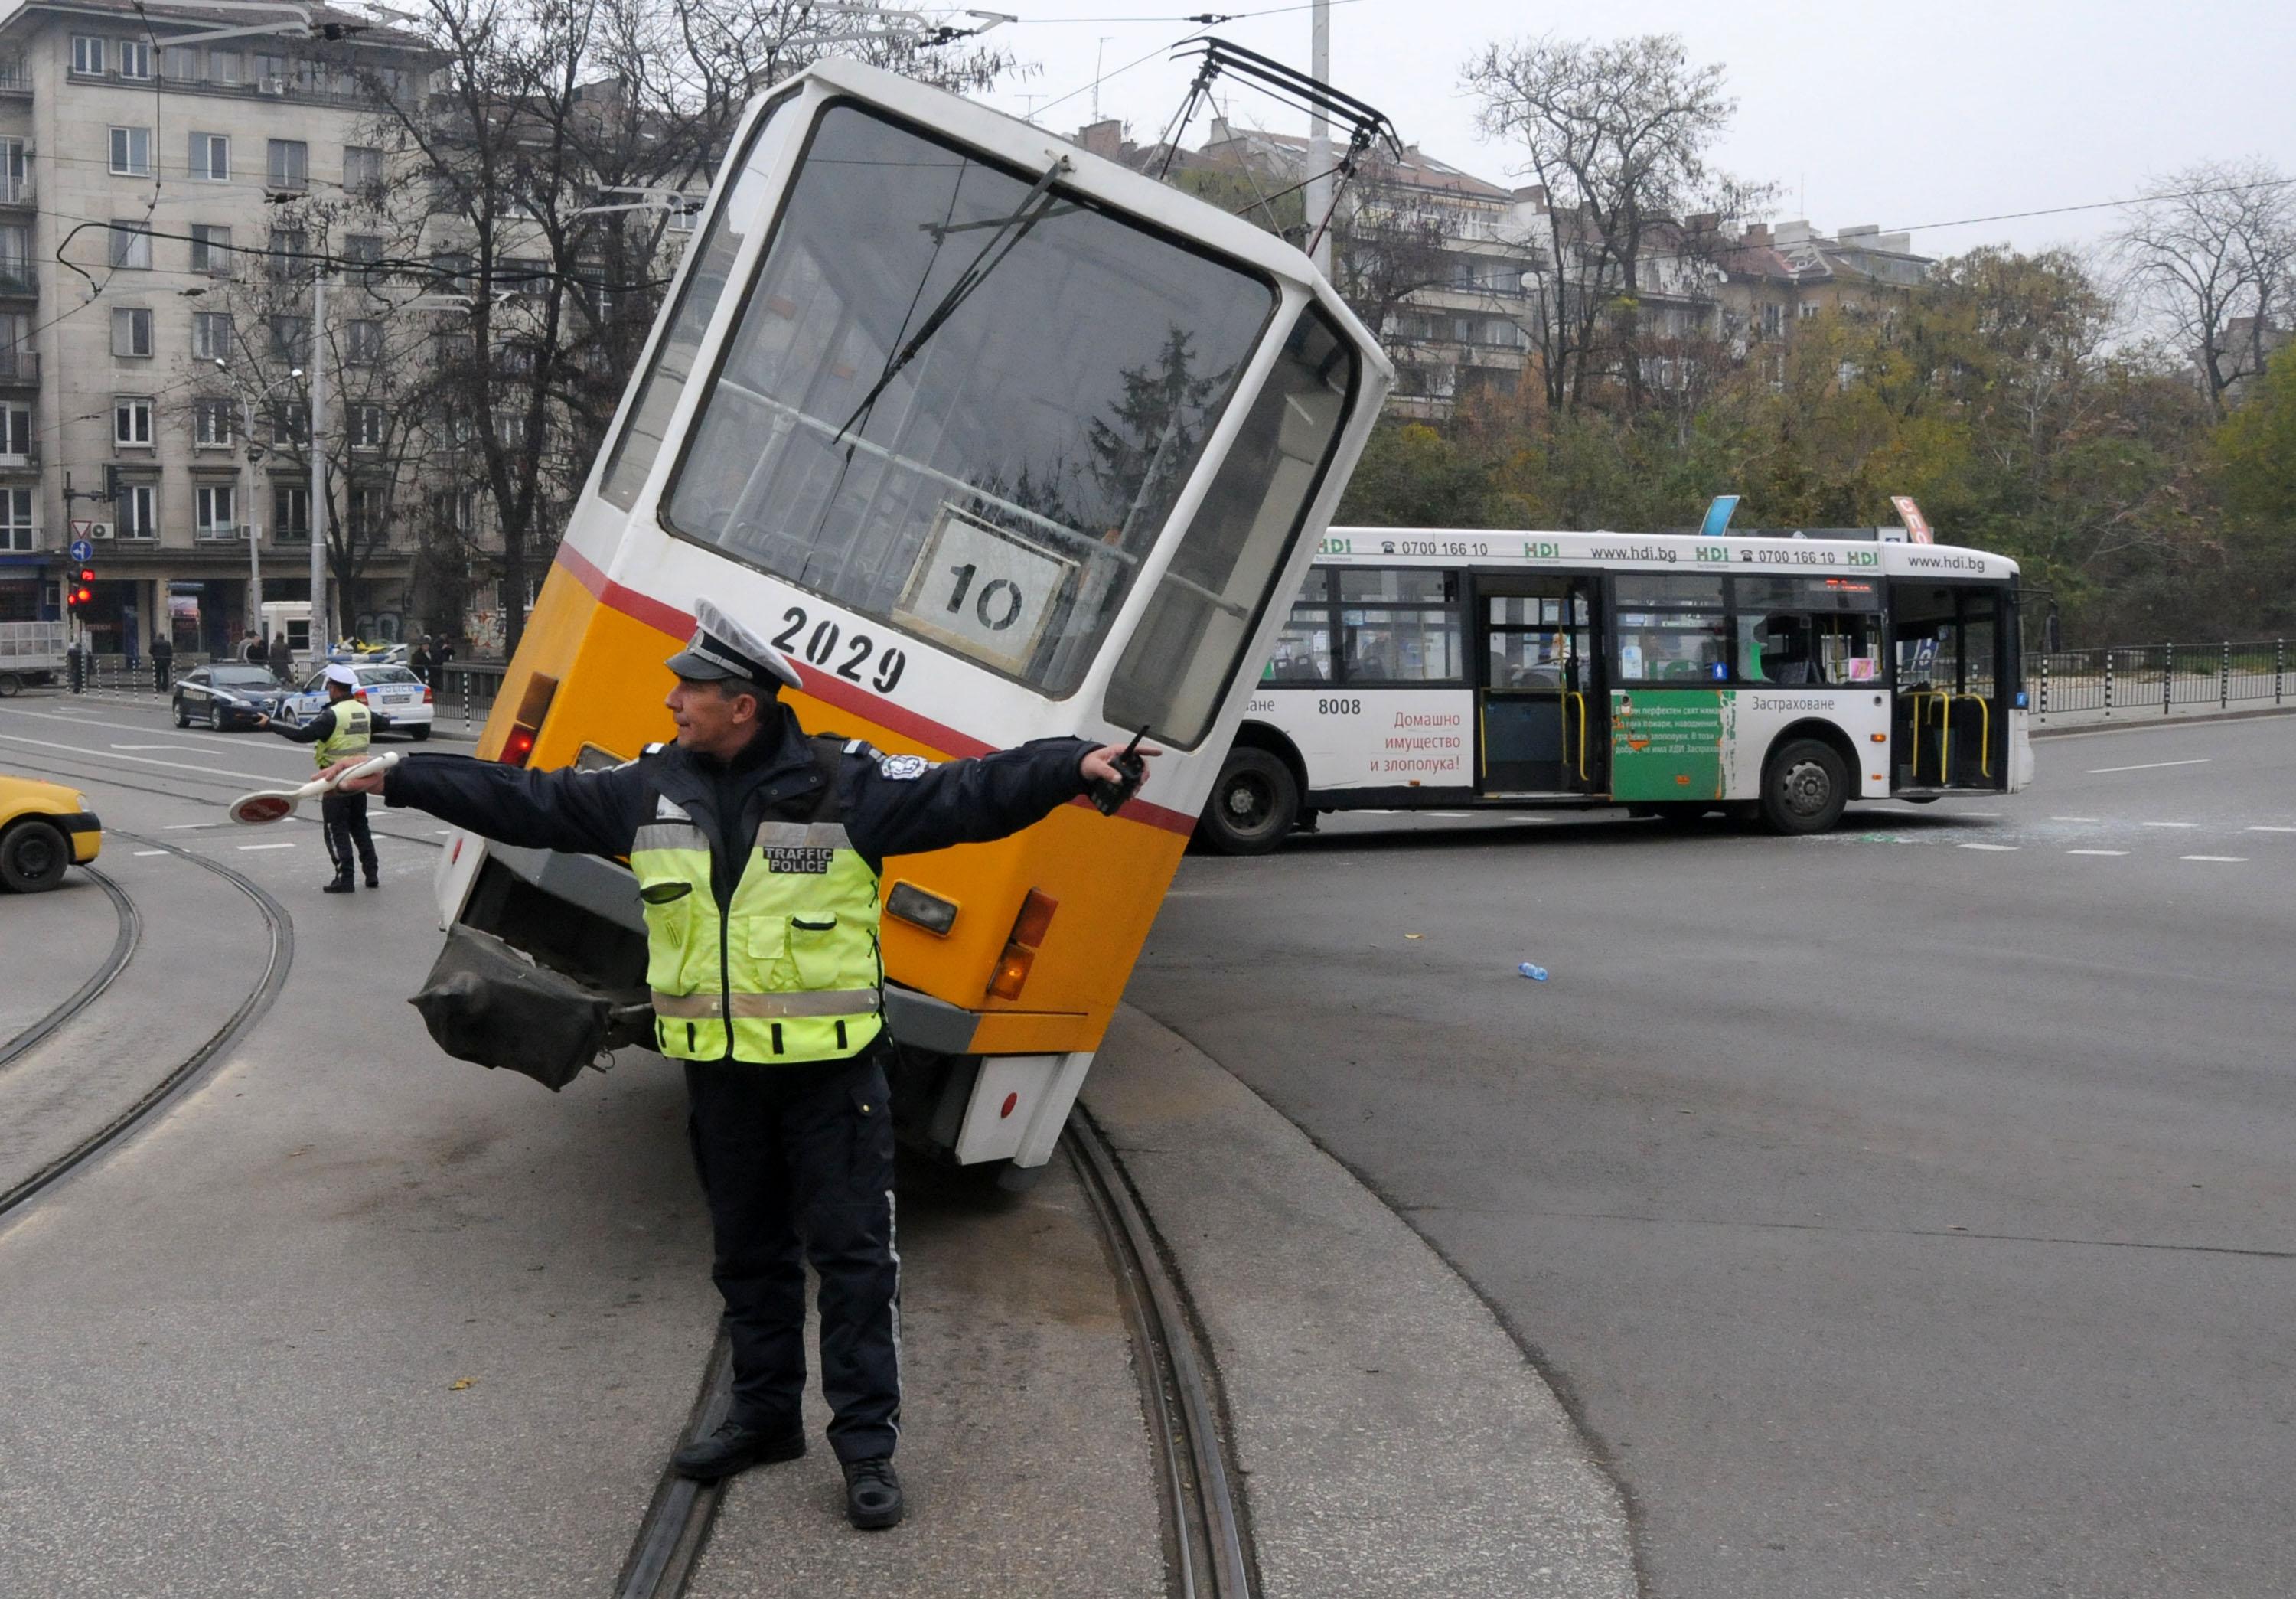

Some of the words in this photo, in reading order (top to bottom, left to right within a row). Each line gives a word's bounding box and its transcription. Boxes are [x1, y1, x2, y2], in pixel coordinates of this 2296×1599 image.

[1402, 541, 1437, 555] 0700
[1442, 543, 1466, 556] 166
[1472, 543, 1488, 556] 10
[1525, 542, 1560, 558] HDI
[1590, 546, 1677, 563] www.hdi.bg
[1695, 547, 1729, 562] HDI
[1759, 550, 1789, 563] 0700
[1794, 551, 1816, 563] 166
[1821, 551, 1835, 564] 10
[1847, 551, 1879, 566] HDI
[1908, 556, 1985, 573] www.hdi.bg
[947, 563, 1022, 631] 10
[771, 606, 906, 693] 2029
[1318, 698, 1362, 715] 8008
[1752, 696, 1835, 713] Застраховане
[1394, 711, 1461, 728] Домашно
[1384, 736, 1461, 751] имущество
[1370, 760, 1378, 772] и
[1384, 755, 1460, 773] злополука!
[764, 847, 833, 860] TRAFFIC
[771, 860, 826, 872] POLICE
